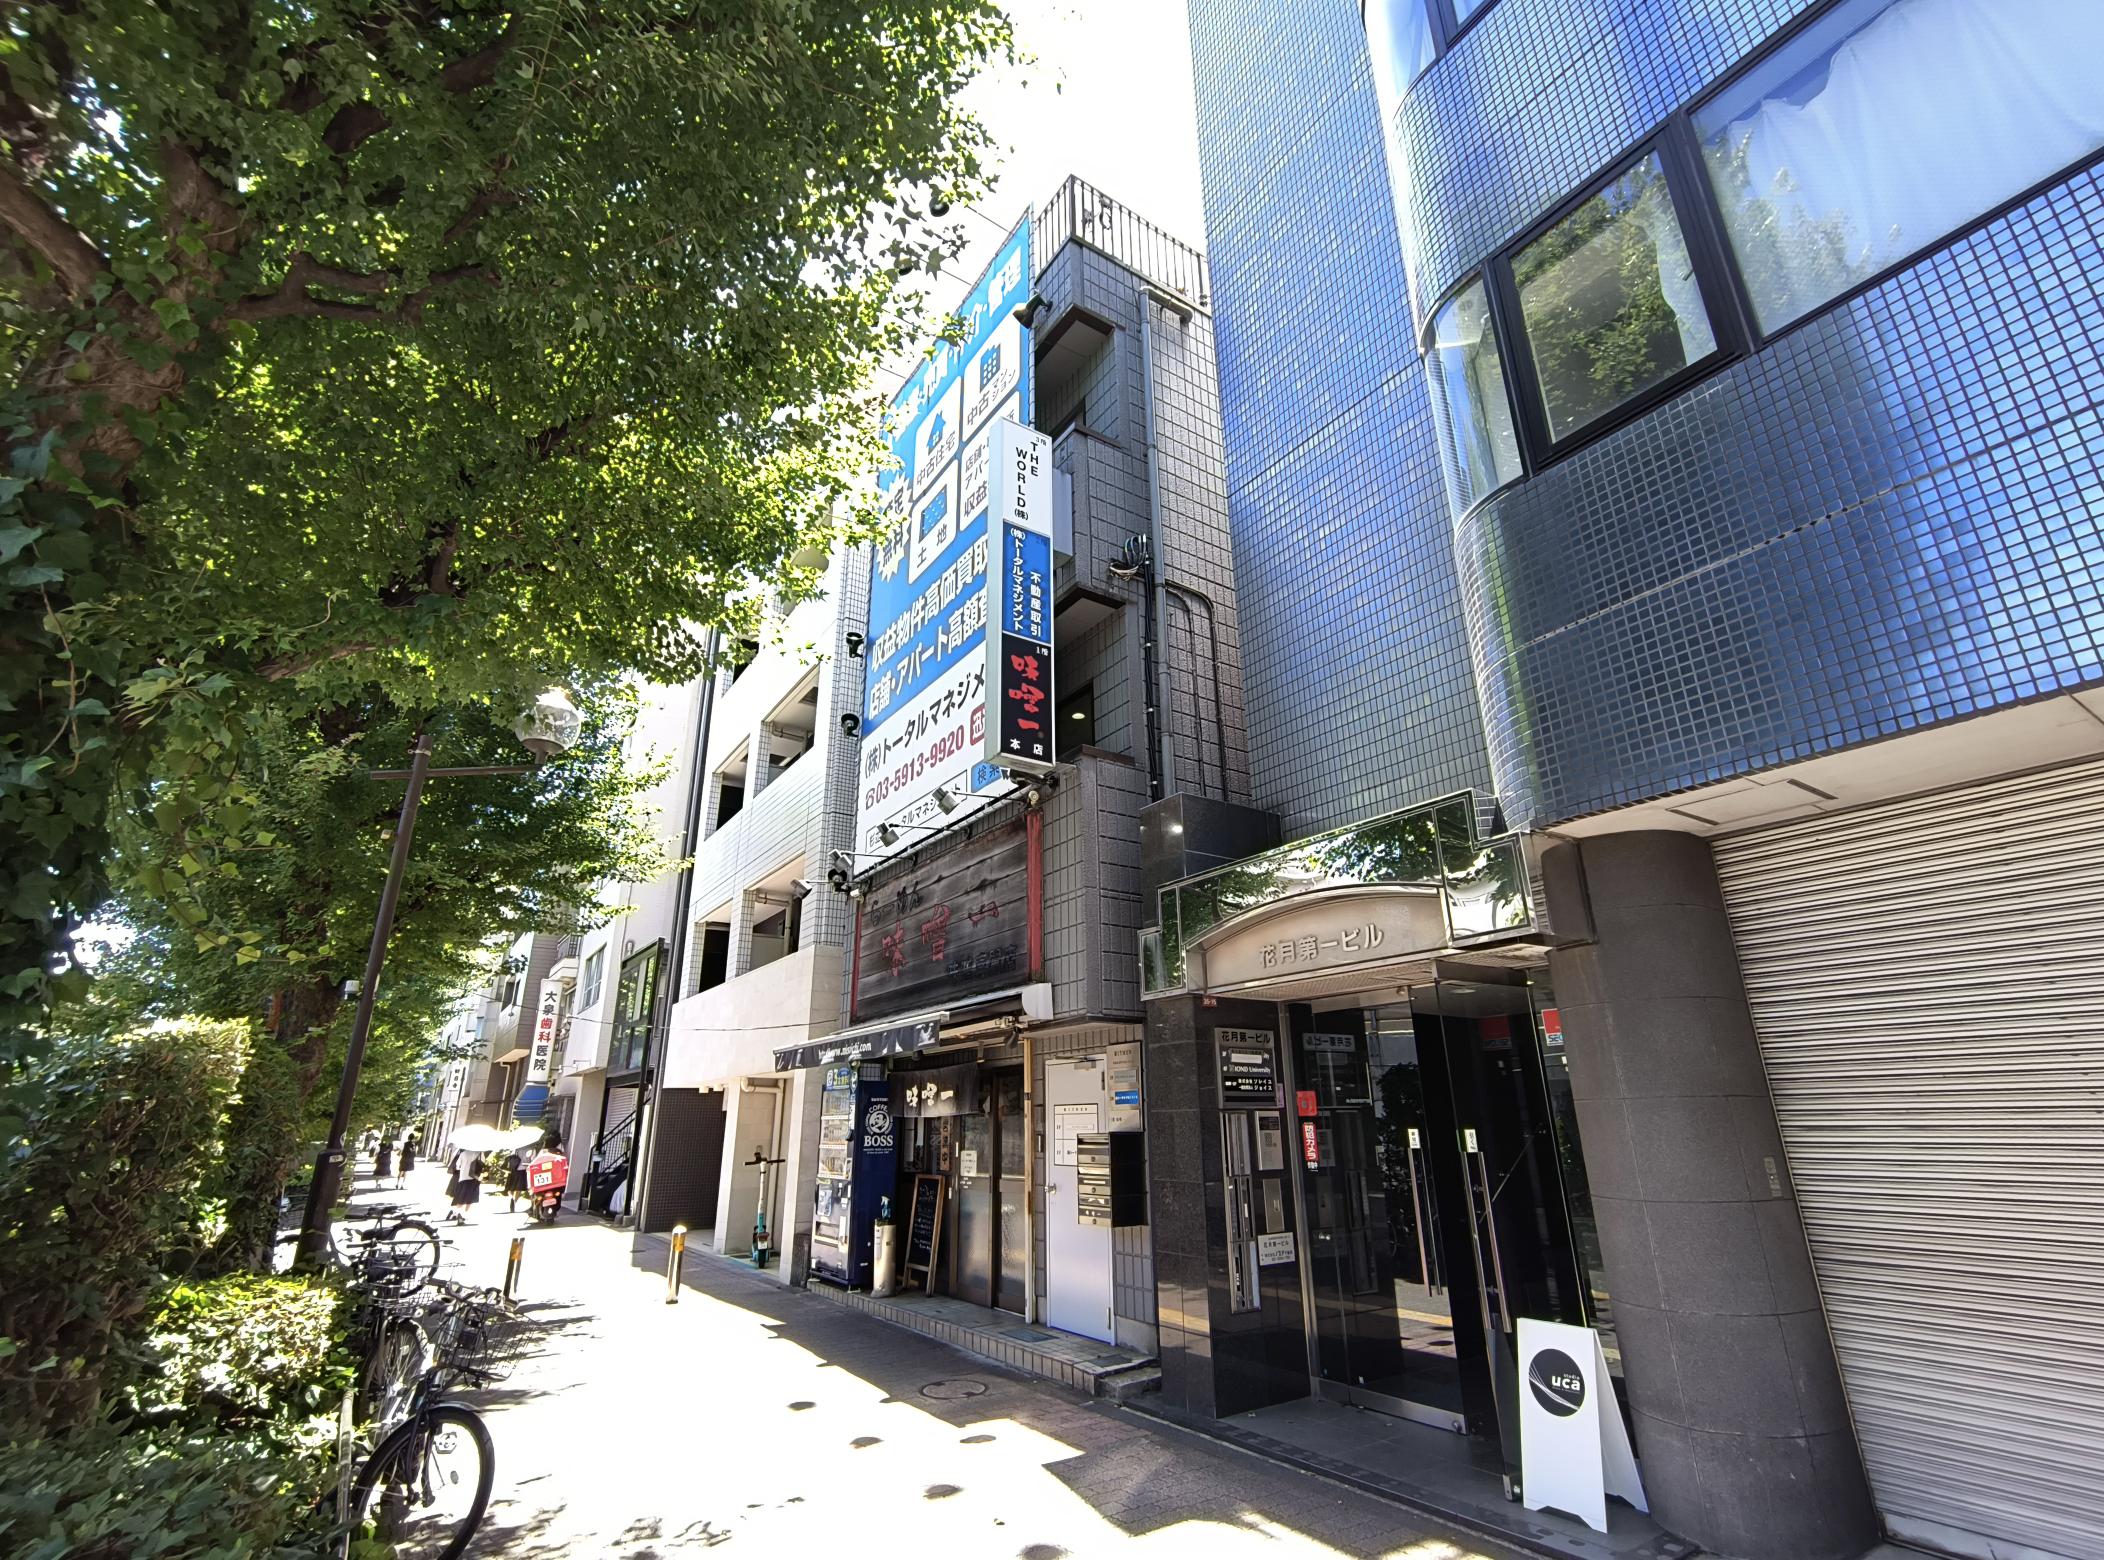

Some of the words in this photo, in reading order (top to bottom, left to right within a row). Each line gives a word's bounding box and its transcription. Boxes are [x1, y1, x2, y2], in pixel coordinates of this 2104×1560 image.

[967, 390, 990, 426] 中古
[916, 430, 956, 487] 中古住宅
[1015, 446, 1028, 508] WORLD
[1030, 441, 1039, 477] THE
[916, 523, 947, 569] 土地
[871, 533, 988, 673] 収益物件高価買取
[1010, 527, 1026, 632] (株)トータルマネジメント
[1030, 571, 1042, 637] 不動産取引
[875, 724, 965, 803] 03-5913-9920
[1009, 738, 1044, 756] 本店
[1259, 921, 1384, 969] 花月第一ビル
[532, 990, 558, 1071] 大泉歯科医院
[1221, 1031, 1271, 1044] 花月第一ビル
[863, 1135, 894, 1147] BOSS
[1551, 1375, 1581, 1391] uca
